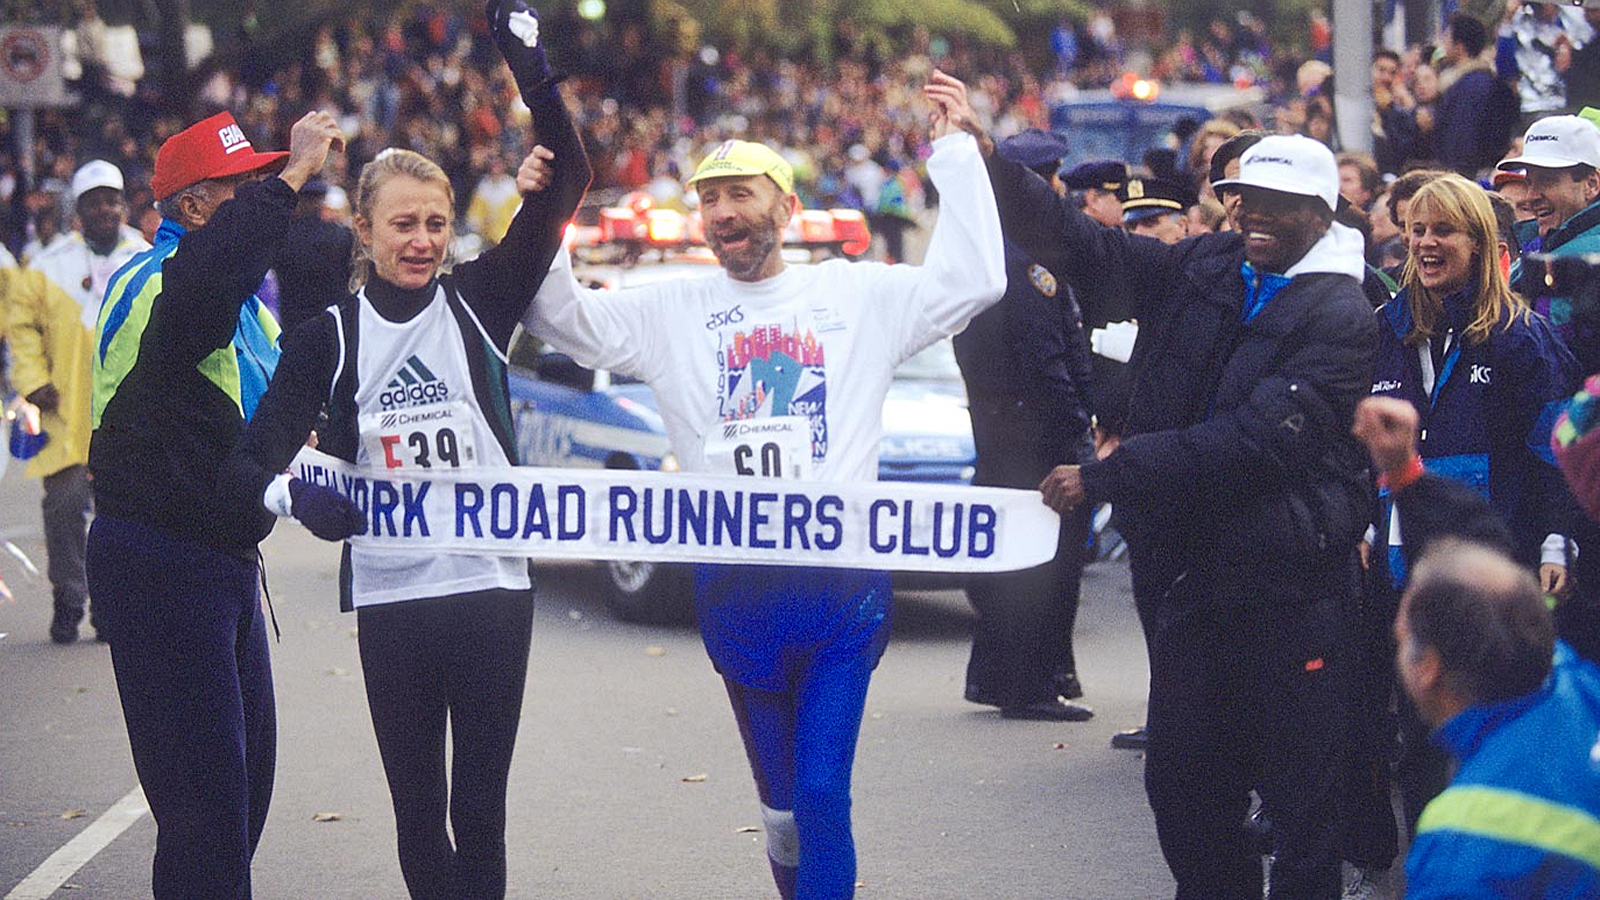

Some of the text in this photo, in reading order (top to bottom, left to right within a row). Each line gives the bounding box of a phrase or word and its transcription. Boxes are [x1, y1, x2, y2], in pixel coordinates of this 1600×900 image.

[218, 124, 247, 148] GIA
[380, 382, 449, 407] adidas
[399, 410, 453, 425] CHEMICAL
[739, 423, 794, 435] CHEMICAL
[455, 483, 585, 541] ROAD
[608, 486, 843, 550] RUNNERS
[869, 499, 996, 558] CLUB
